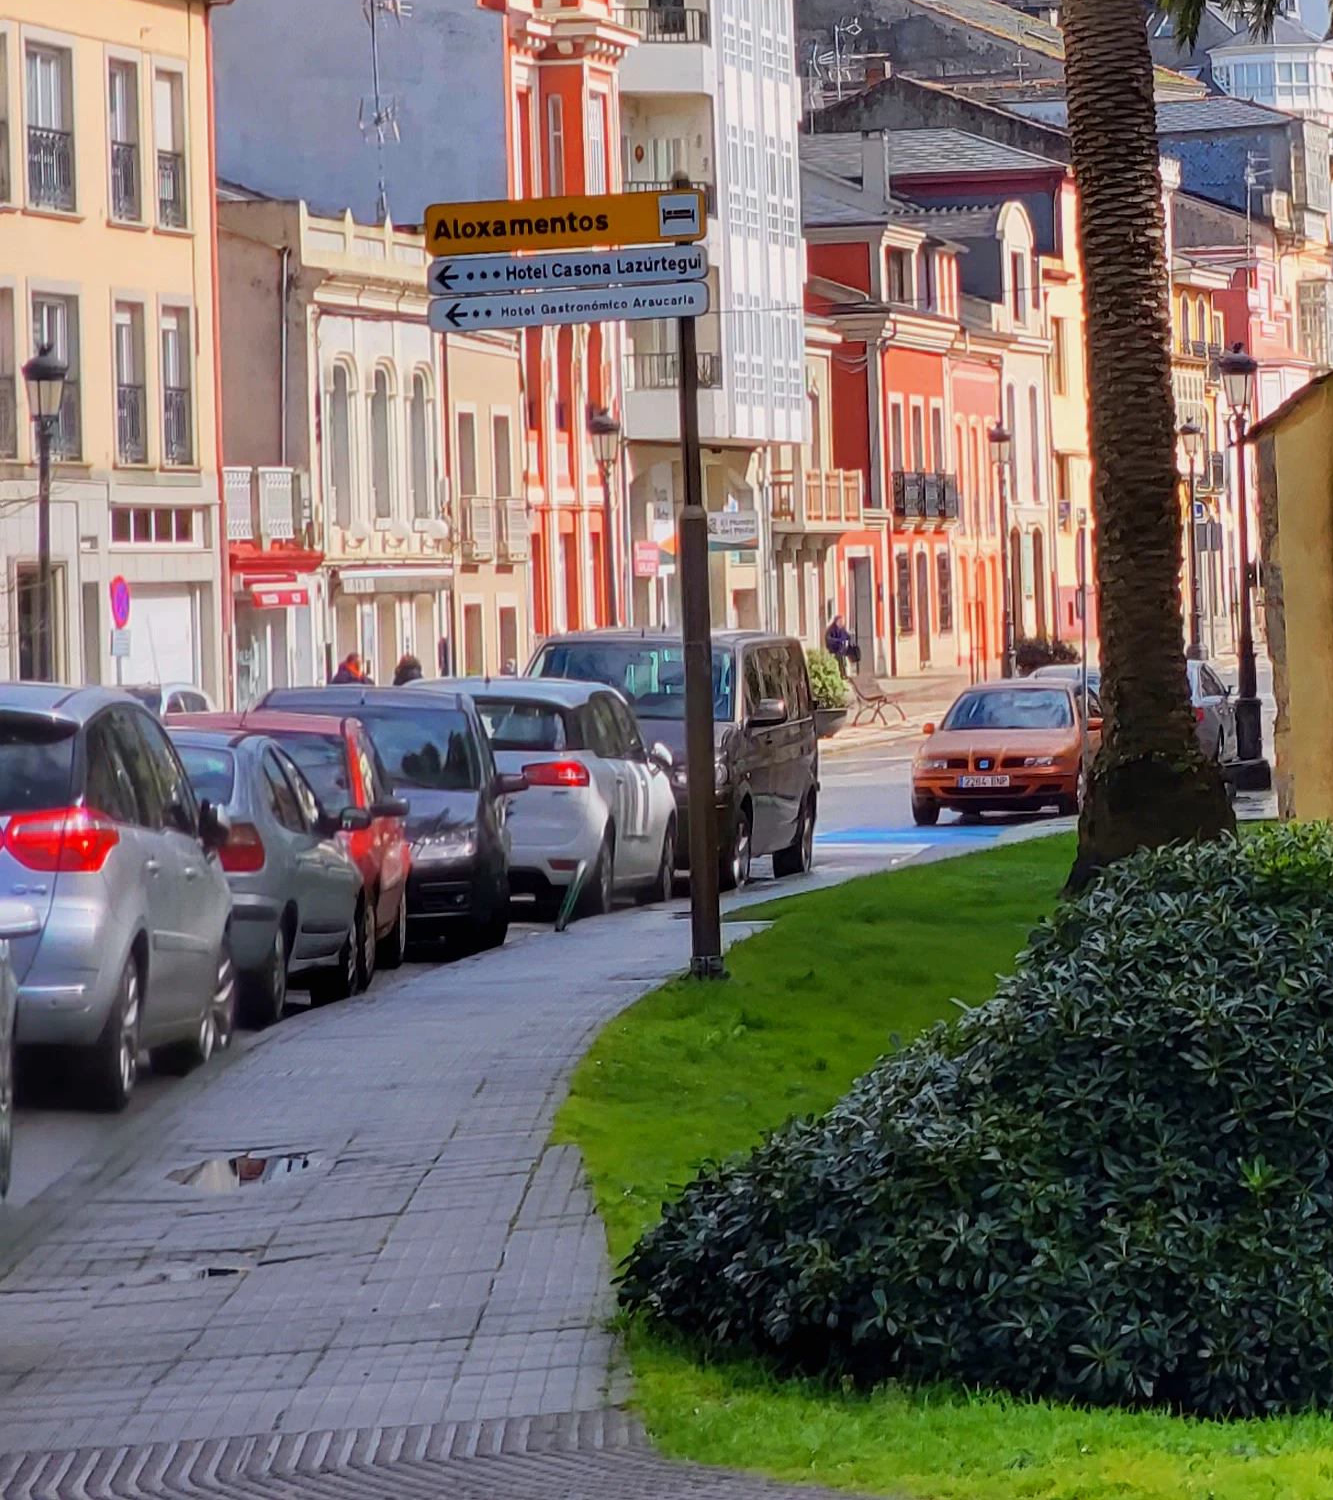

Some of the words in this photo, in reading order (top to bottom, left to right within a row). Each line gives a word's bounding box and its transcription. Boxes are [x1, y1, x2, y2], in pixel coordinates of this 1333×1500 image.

[434, 211, 609, 241] Aloxamentos
[505, 263, 548, 281] Hotel
[552, 262, 611, 278] Casona
[617, 253, 702, 275] Lazúrtegui
[501, 304, 535, 317] Hotel
[541, 299, 628, 315] Gastronómico
[633, 294, 695, 308] Araucaria
